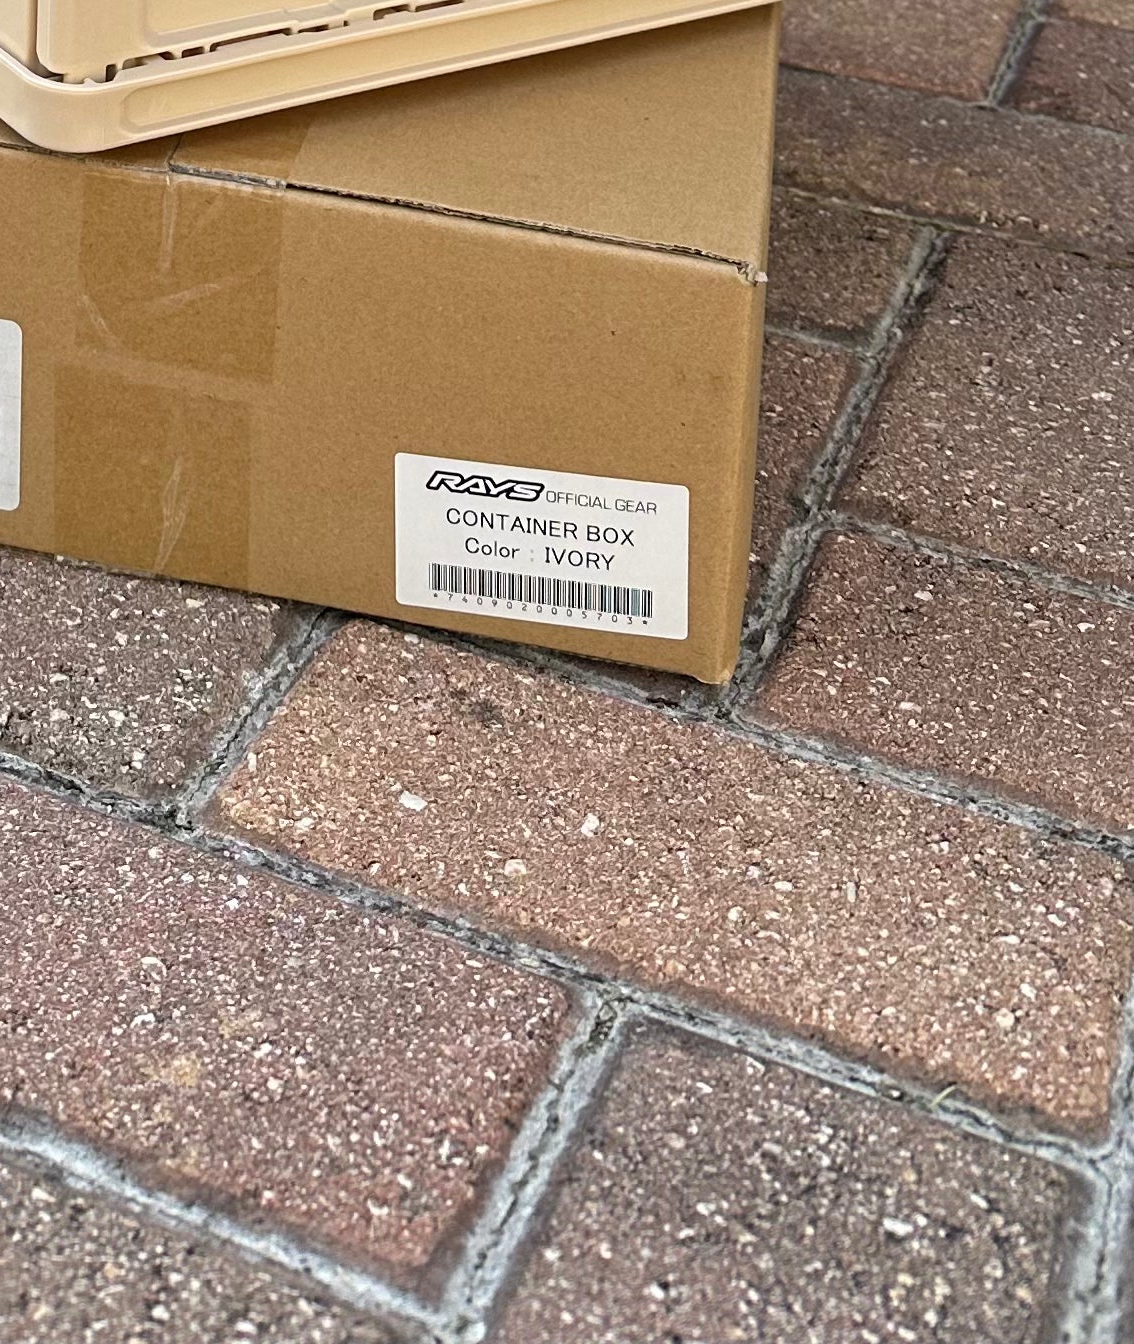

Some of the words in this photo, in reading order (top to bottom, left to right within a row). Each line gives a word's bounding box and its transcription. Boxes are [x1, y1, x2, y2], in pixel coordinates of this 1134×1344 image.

[426, 470, 545, 502] RAYS
[546, 490, 612, 510] OFFICIAL
[615, 498, 657, 515] GEAR
[446, 507, 578, 540] CONTAINER
[586, 525, 635, 547] BOX
[464, 537, 520, 559] Color
[545, 546, 615, 571] IVORY
